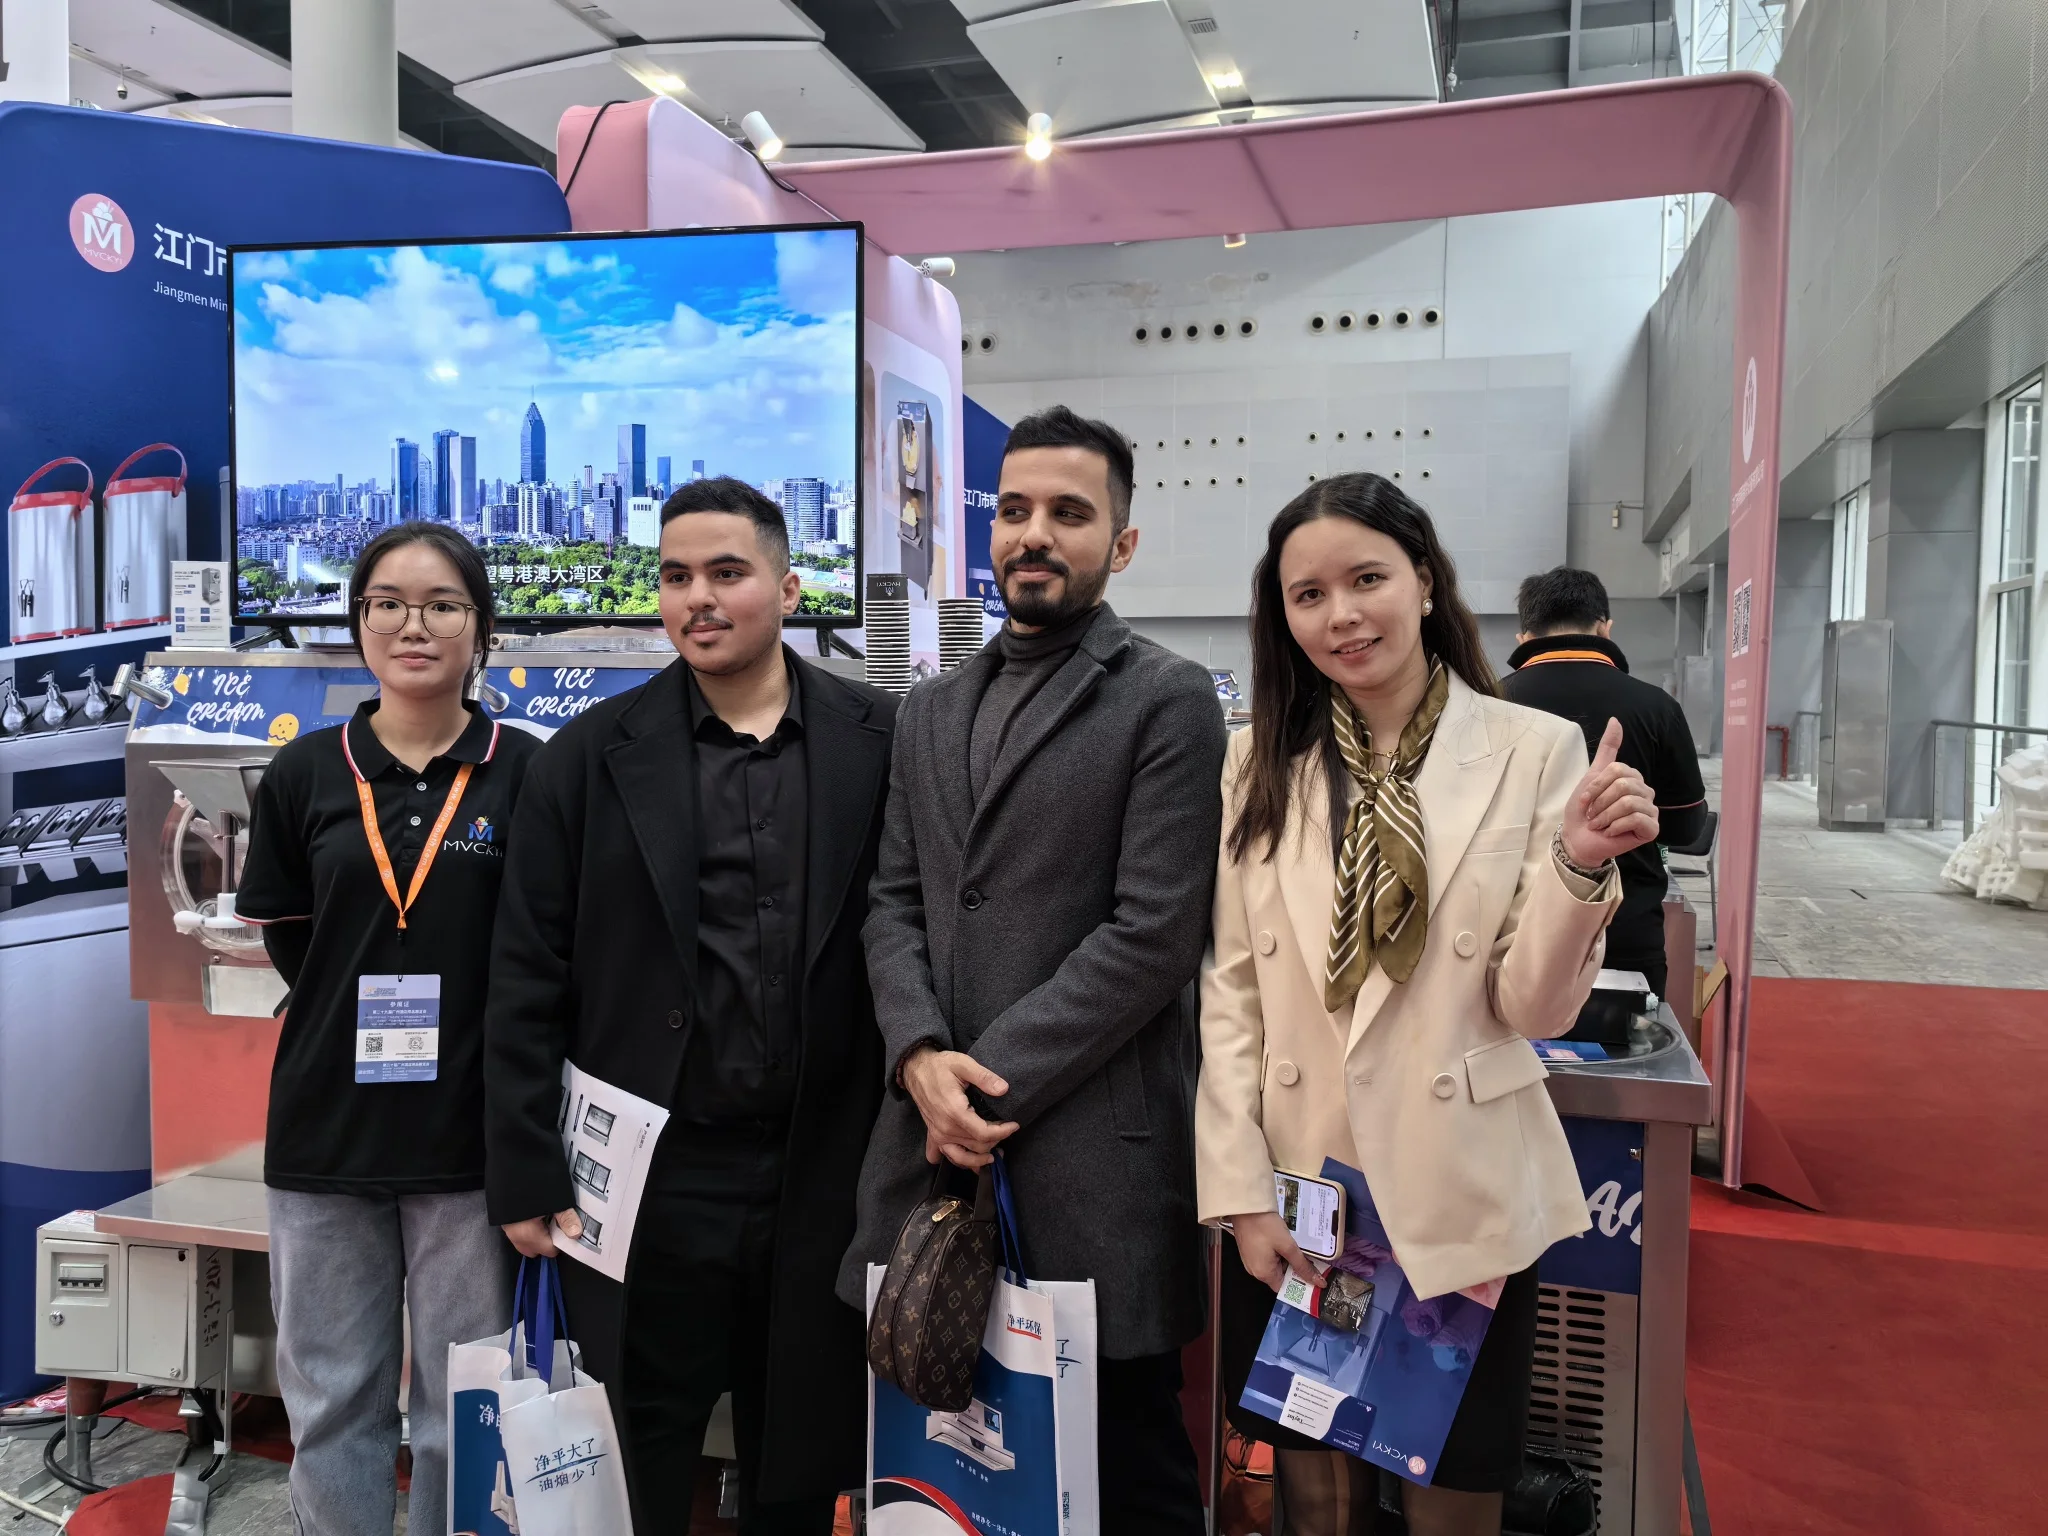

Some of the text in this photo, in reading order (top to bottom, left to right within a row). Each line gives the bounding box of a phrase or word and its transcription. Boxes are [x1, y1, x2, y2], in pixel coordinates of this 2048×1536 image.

[153, 281, 208, 307] Jiangmen
[213, 672, 252, 696] ICE
[553, 667, 595, 689] ICE
[186, 701, 266, 723] CREAM
[533, 1437, 595, 1472] 净平大了
[539, 1460, 599, 1492] 油烟少了
